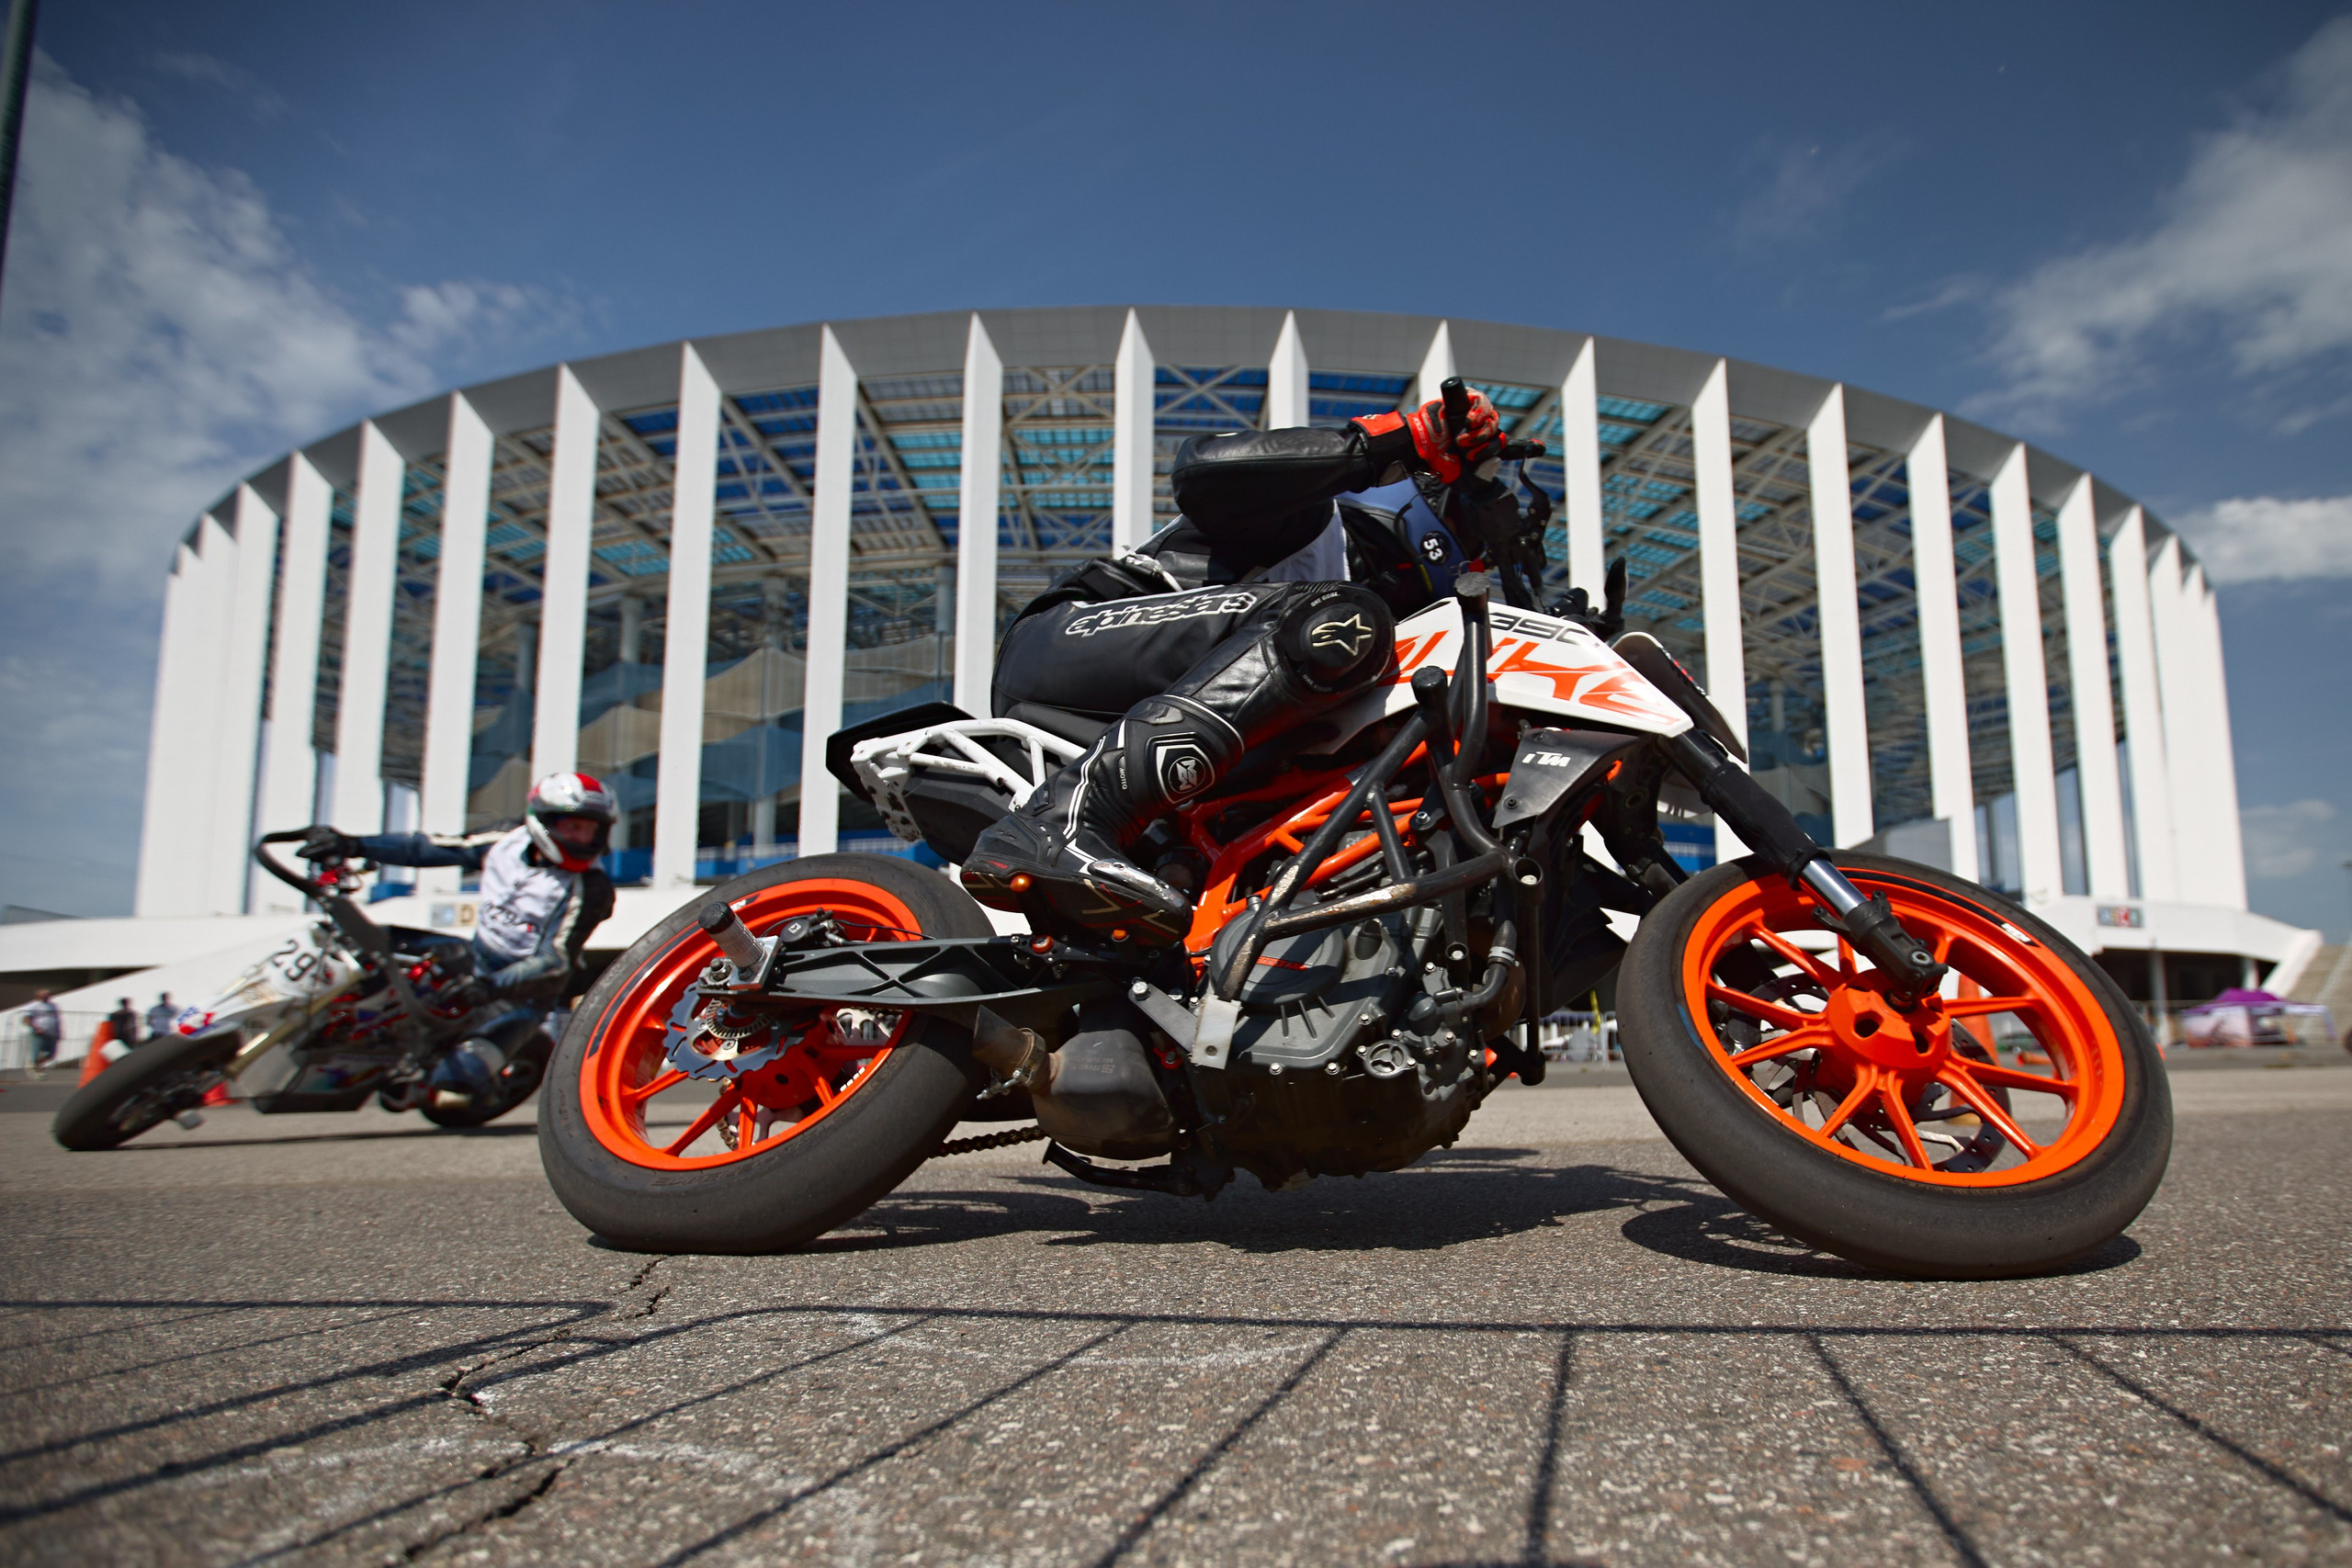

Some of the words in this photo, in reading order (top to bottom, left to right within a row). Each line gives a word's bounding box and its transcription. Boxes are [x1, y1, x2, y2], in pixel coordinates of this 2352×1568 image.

[1423, 537, 1443, 560] 53
[1118, 767, 1128, 790] MOTO
[272, 940, 318, 982] 29
